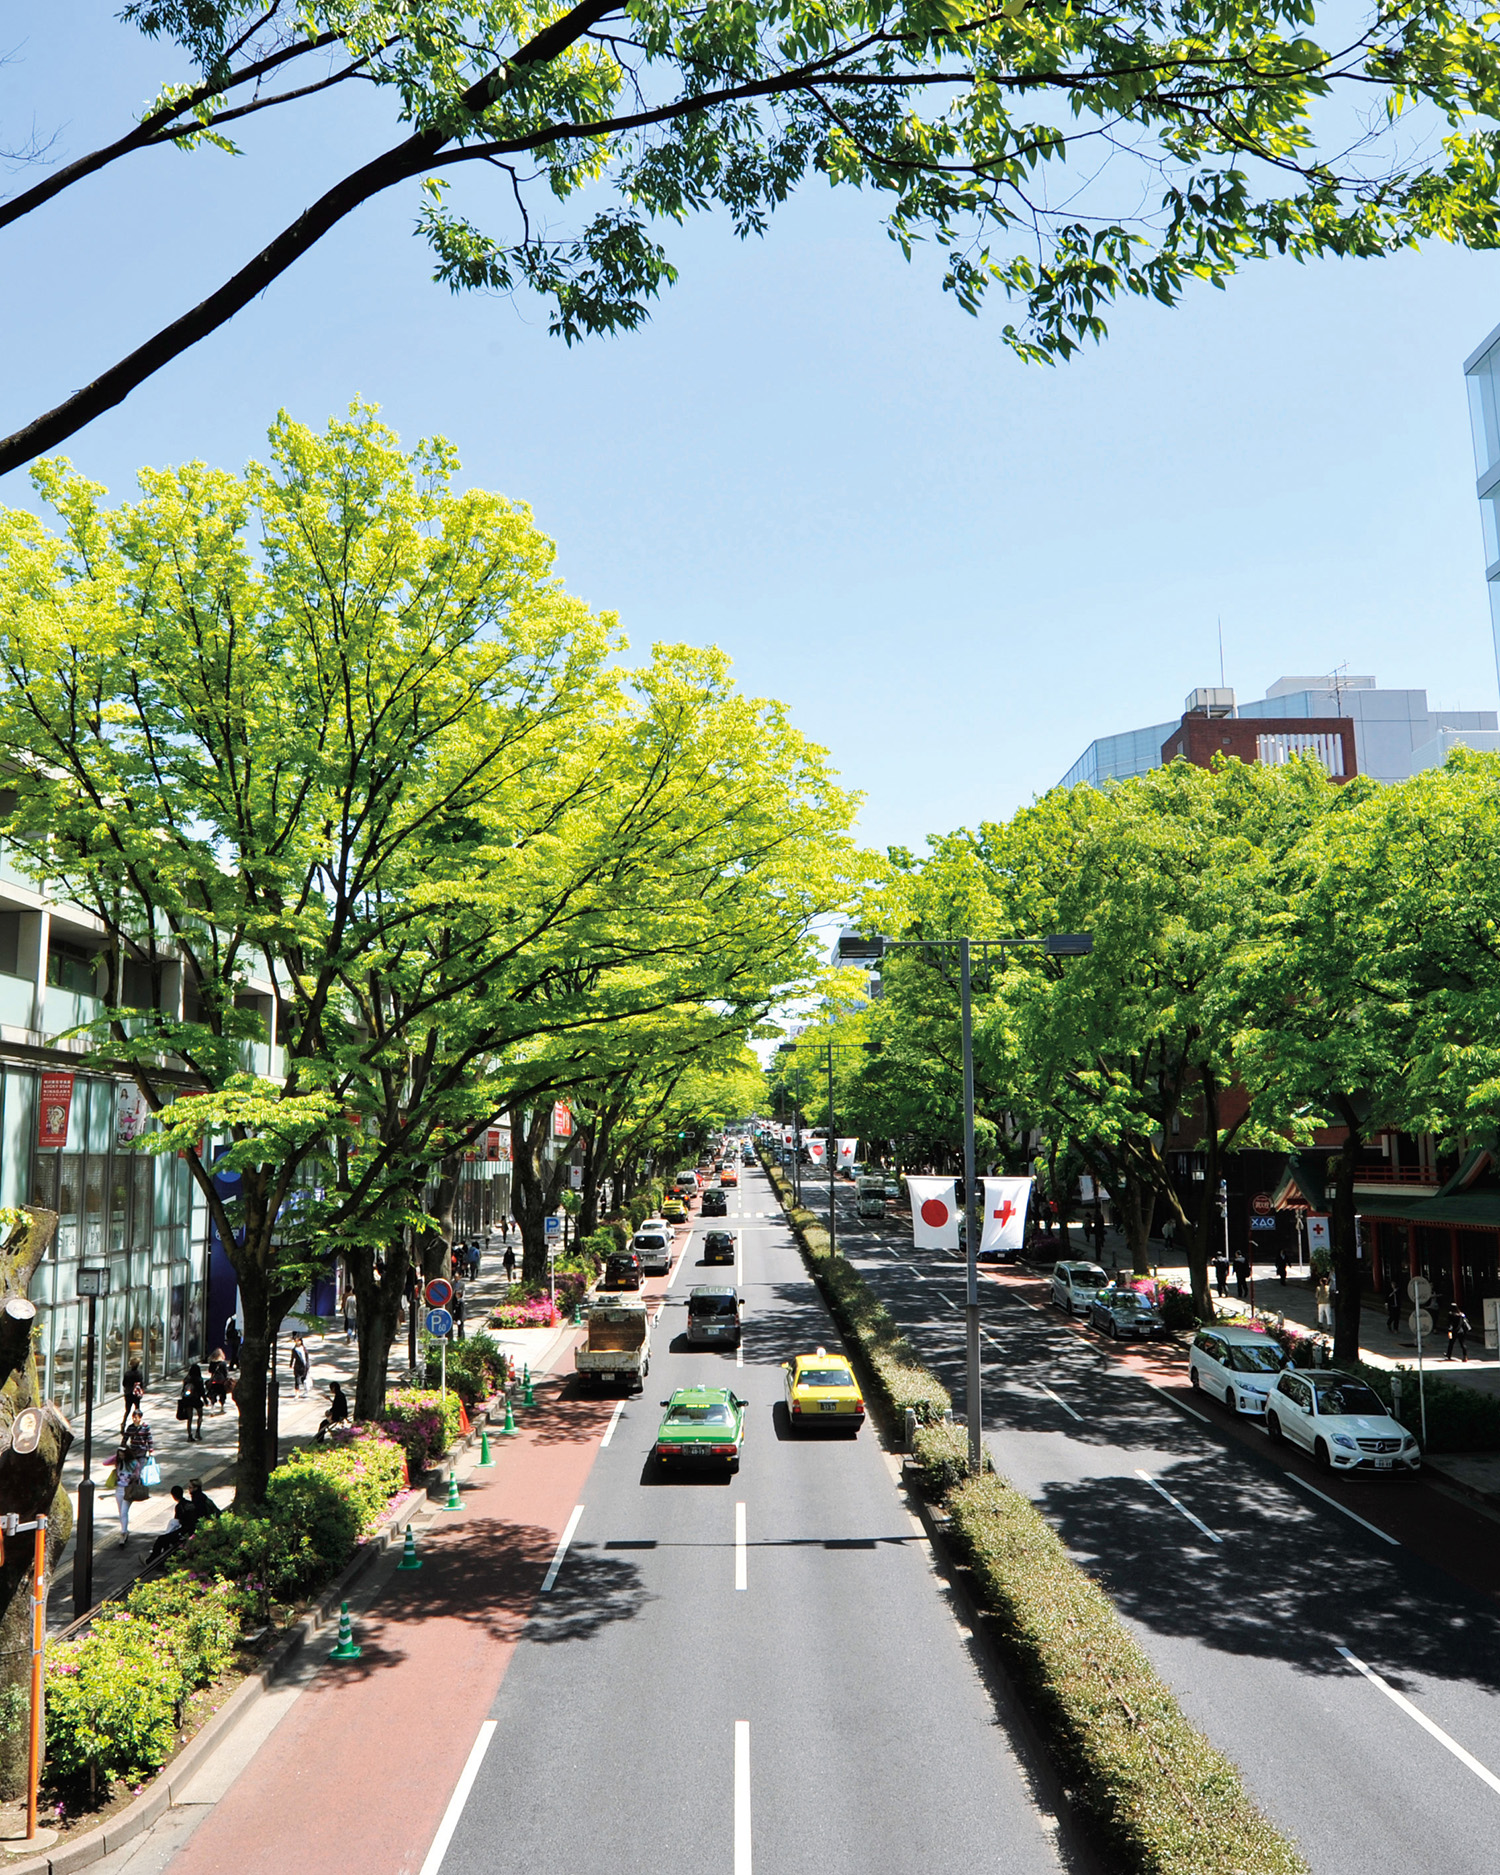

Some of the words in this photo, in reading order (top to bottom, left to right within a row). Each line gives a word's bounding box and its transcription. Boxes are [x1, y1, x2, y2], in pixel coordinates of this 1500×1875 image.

[546, 1218, 559, 1232] P
[431, 1315, 442, 1332] P
[438, 1324, 447, 1332] 60
